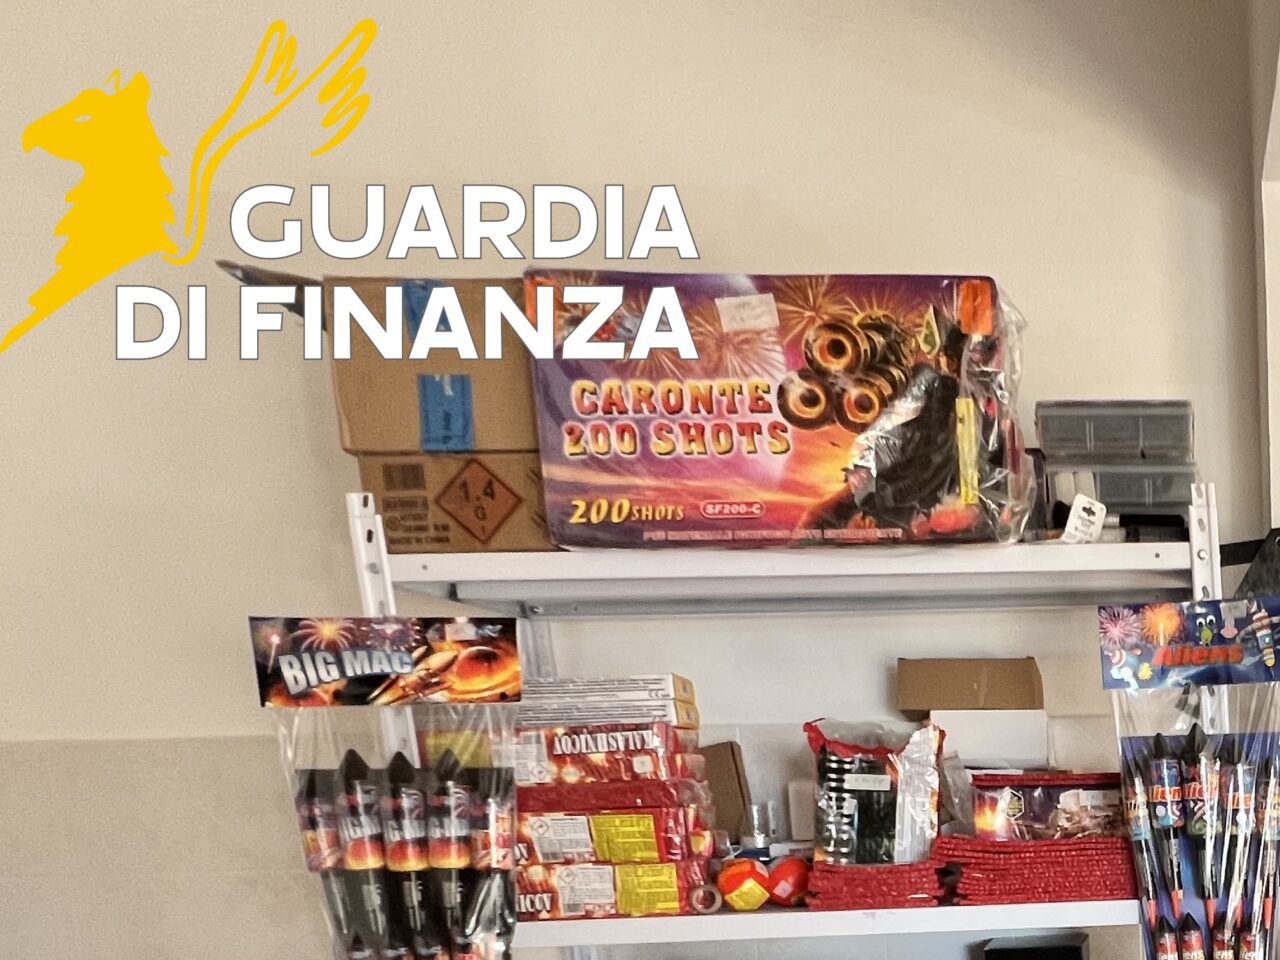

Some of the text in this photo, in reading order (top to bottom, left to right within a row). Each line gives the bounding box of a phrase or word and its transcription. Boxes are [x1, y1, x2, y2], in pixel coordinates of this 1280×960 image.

[573, 378, 773, 416] CARONTE
[563, 420, 793, 456] 200 SHOTS
[569, 498, 631, 524] 200
[631, 504, 685, 522] SHOTS
[278, 650, 414, 695] BIG MAC
